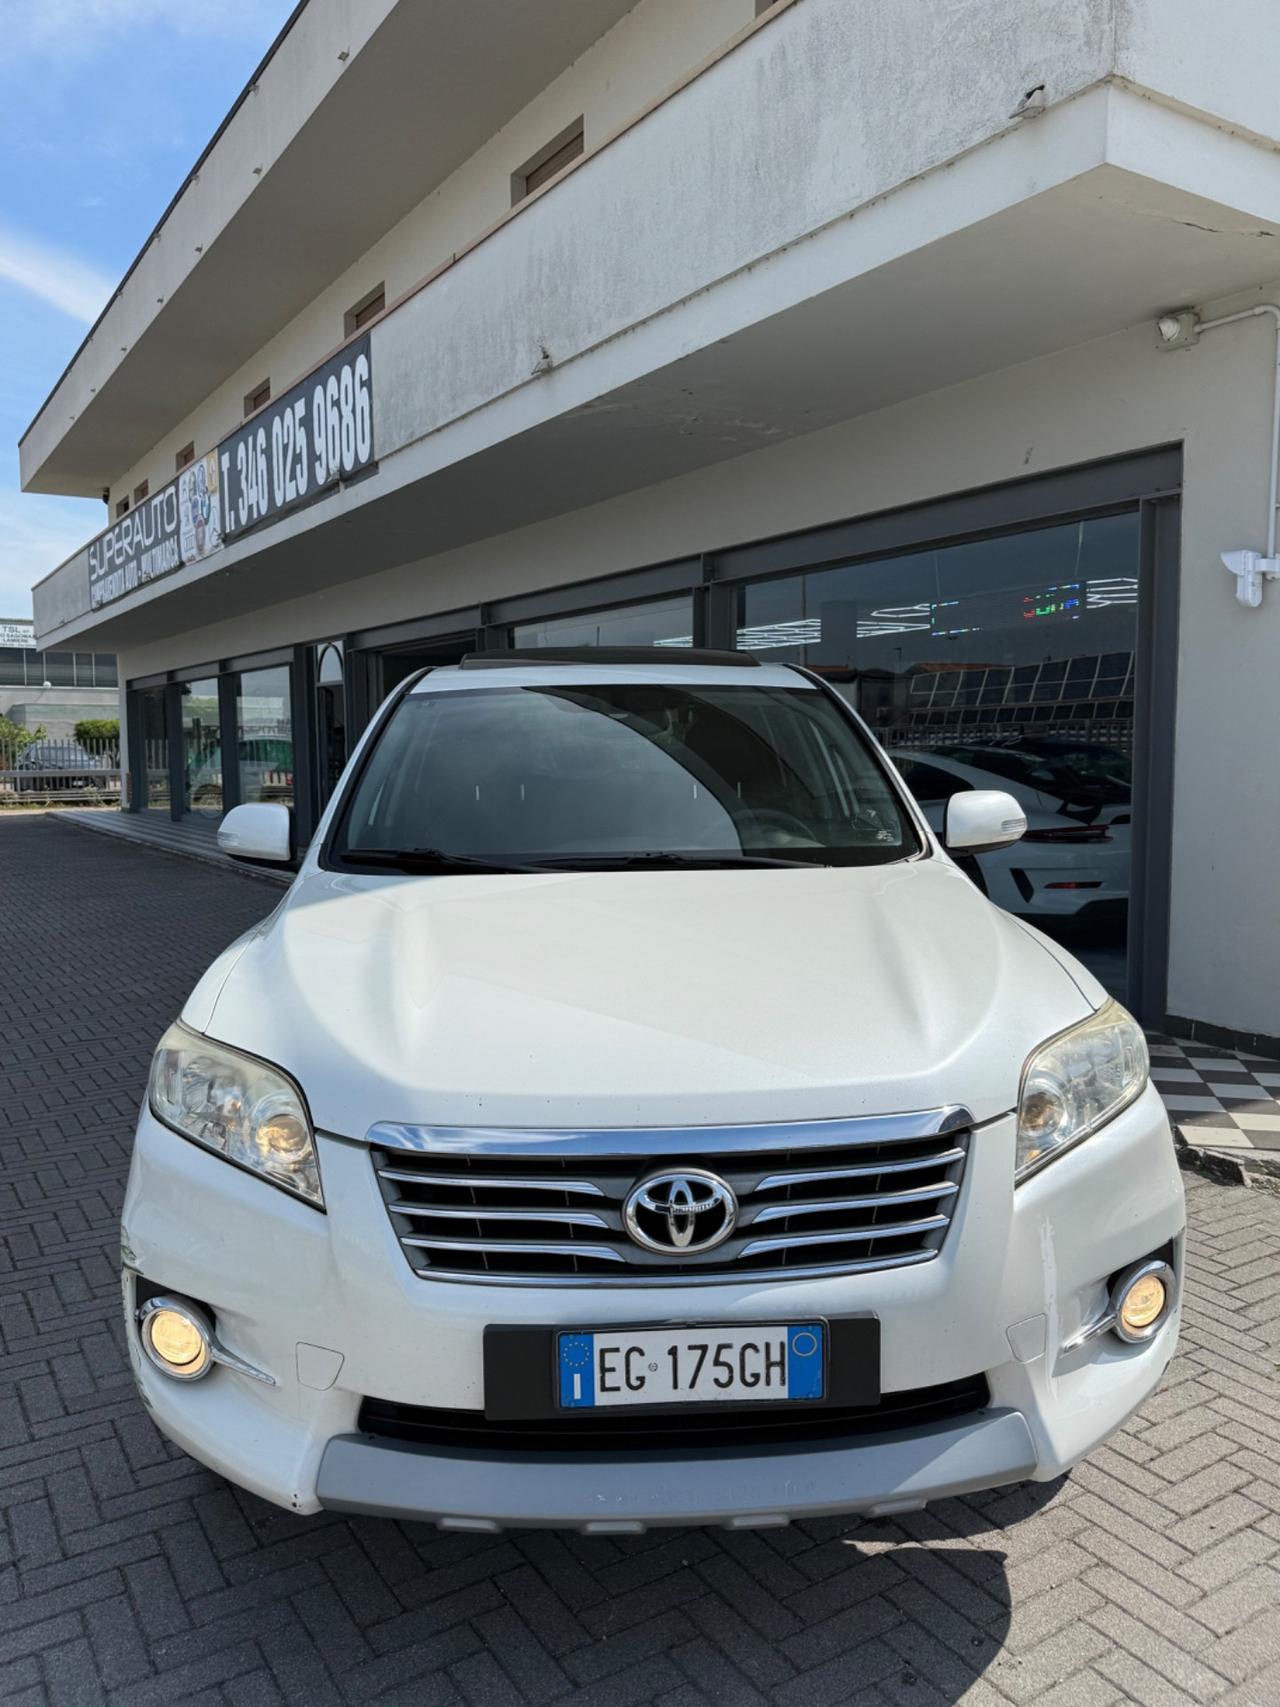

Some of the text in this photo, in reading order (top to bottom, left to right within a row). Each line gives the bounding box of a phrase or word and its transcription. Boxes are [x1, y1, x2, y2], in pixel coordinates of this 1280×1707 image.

[221, 354, 371, 533] T. 346 025 9686
[89, 485, 177, 580] SUPERAUTO
[599, 1341, 786, 1393] EG 175GH
